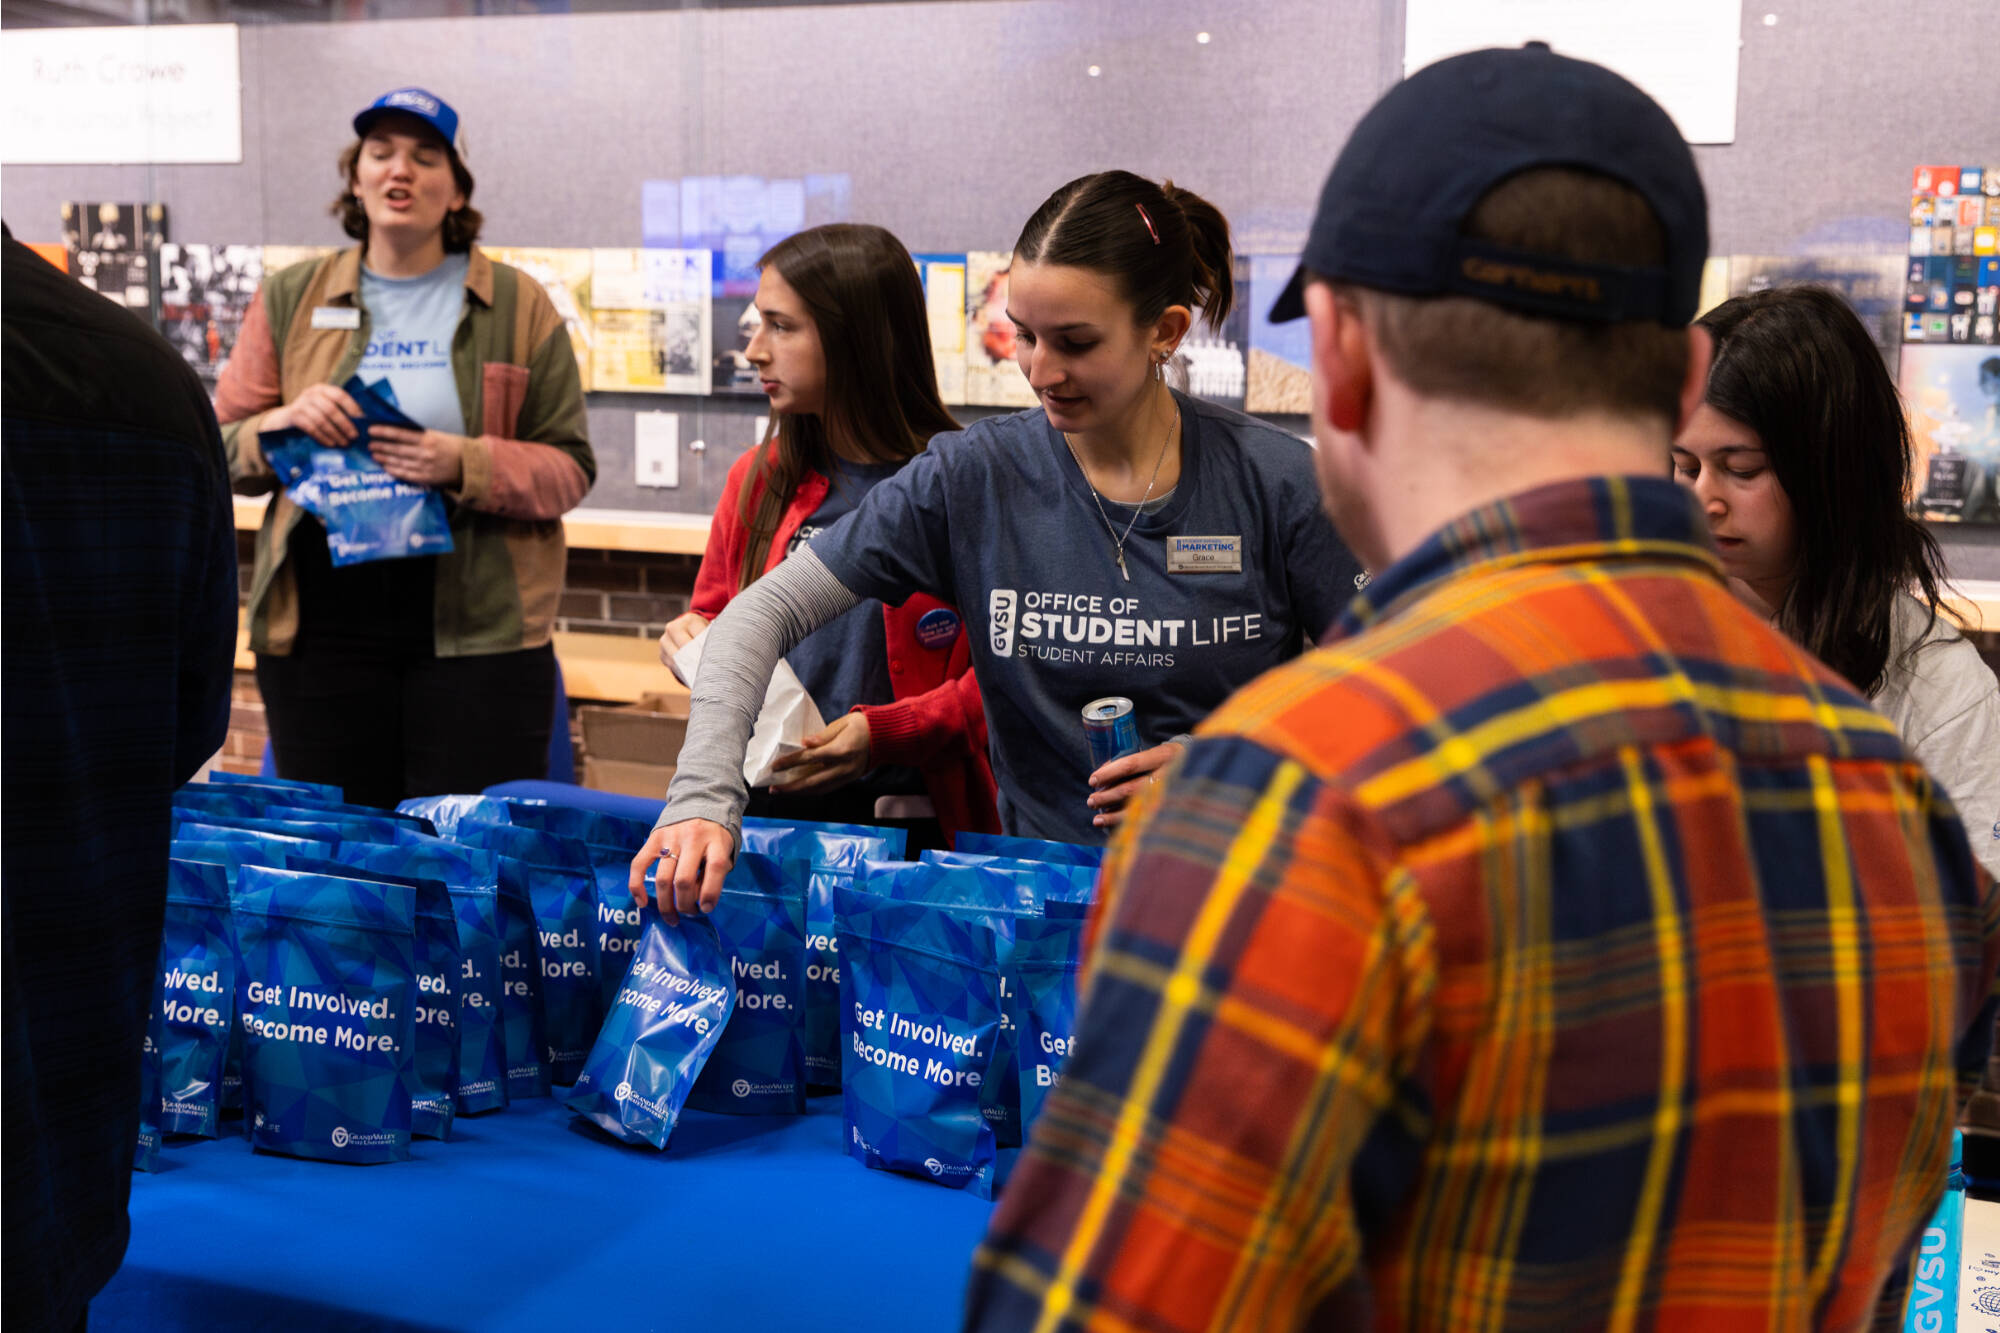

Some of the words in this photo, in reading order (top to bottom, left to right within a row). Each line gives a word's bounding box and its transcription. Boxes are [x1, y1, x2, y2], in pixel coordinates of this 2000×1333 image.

[365, 340, 429, 357] DENT
[1183, 543, 1234, 551] MARKETING
[1024, 592, 1103, 614] OFFICE
[1109, 597, 1139, 615] OF
[994, 597, 1011, 651] GVSU
[1020, 612, 1185, 647] STUDENT
[1192, 613, 1262, 646] LIFE
[1018, 644, 1095, 665] STUDENT
[1100, 651, 1175, 668] AFFAIRS
[541, 957, 592, 978] ore.
[631, 957, 655, 979] et
[651, 966, 724, 1008] Involved.
[731, 955, 787, 980] lved.
[247, 981, 282, 1006] Get
[289, 985, 396, 1020] Involved.
[504, 980, 534, 996] re.
[242, 1012, 328, 1045] Become
[334, 1025, 400, 1052] More.
[416, 1006, 455, 1028] ore.
[660, 1001, 712, 1039] More.
[854, 1001, 886, 1031] Get
[890, 1012, 983, 1058] Involved.
[853, 1030, 920, 1076] Become
[1040, 1031, 1077, 1057] Get
[1914, 1227, 1947, 1333] GVSU
